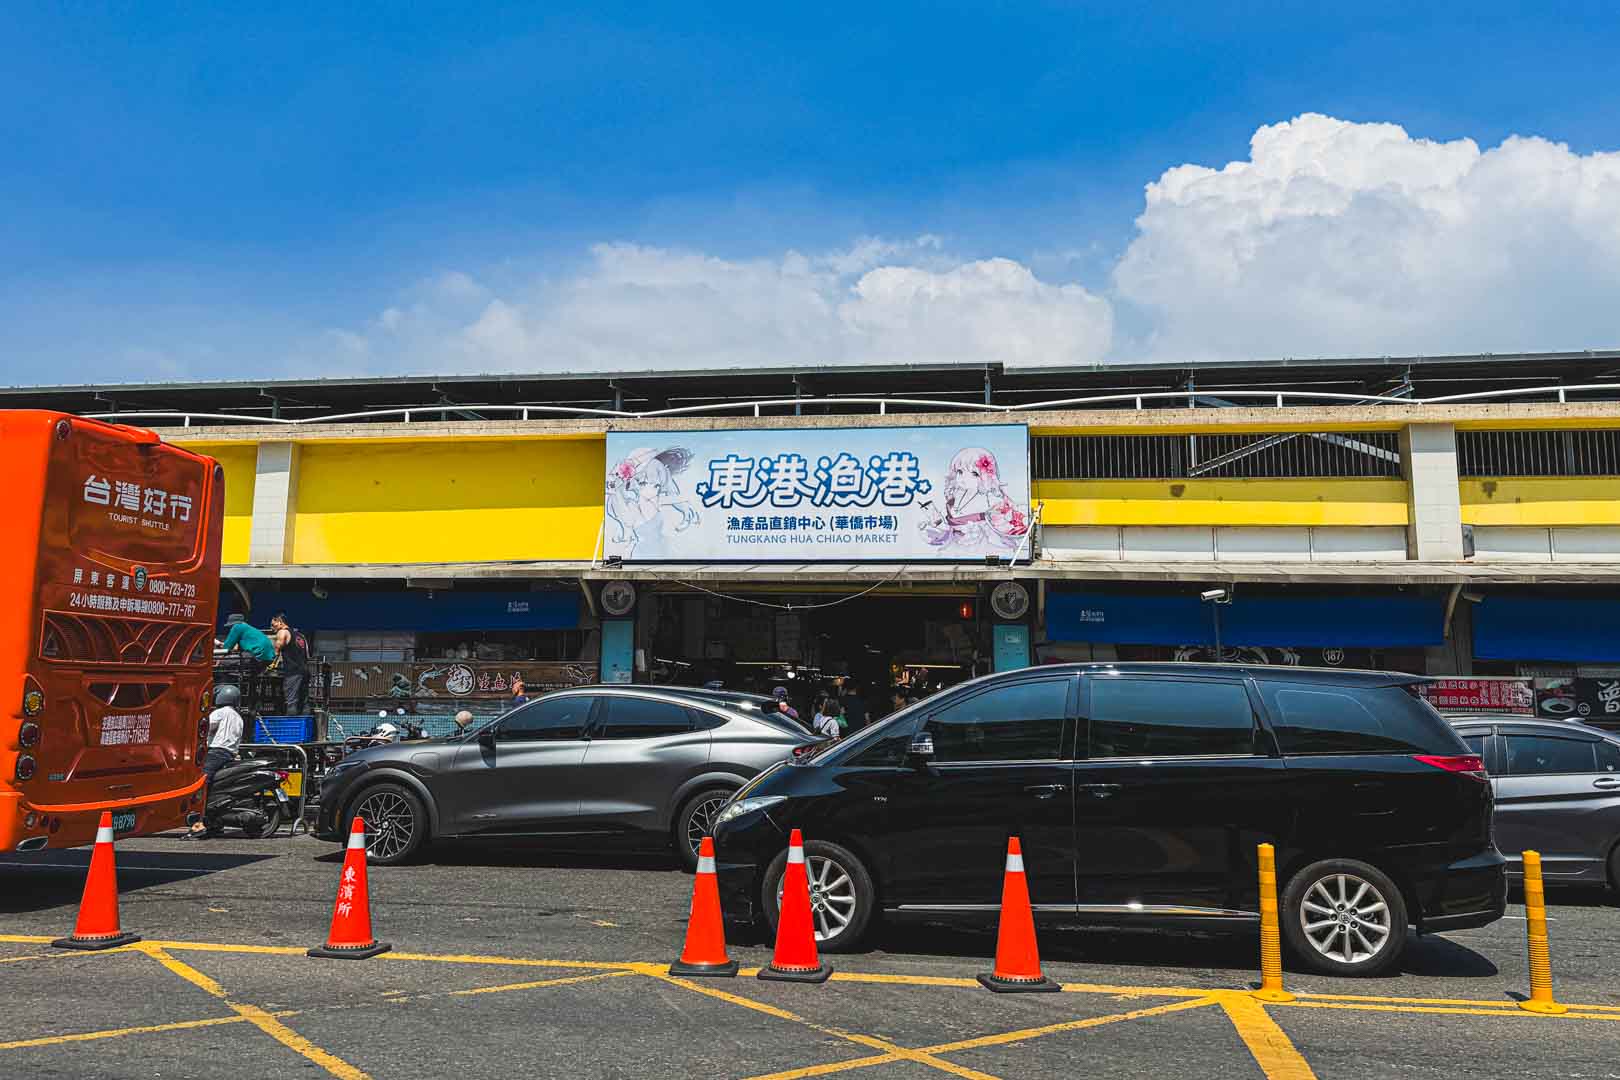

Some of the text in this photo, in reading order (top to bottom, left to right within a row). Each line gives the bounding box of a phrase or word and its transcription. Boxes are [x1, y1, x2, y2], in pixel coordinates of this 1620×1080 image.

[702, 452, 919, 508] 東港漁港
[84, 474, 192, 521] 台灣好行
[108, 512, 170, 531] TOURIST SHUTTLE
[727, 515, 898, 531] 漁產品直銷中心 (華僑市場)
[727, 533, 898, 544] TUNGKANG HUA CHIAO MARKET
[149, 579, 196, 598] 0800-723-723
